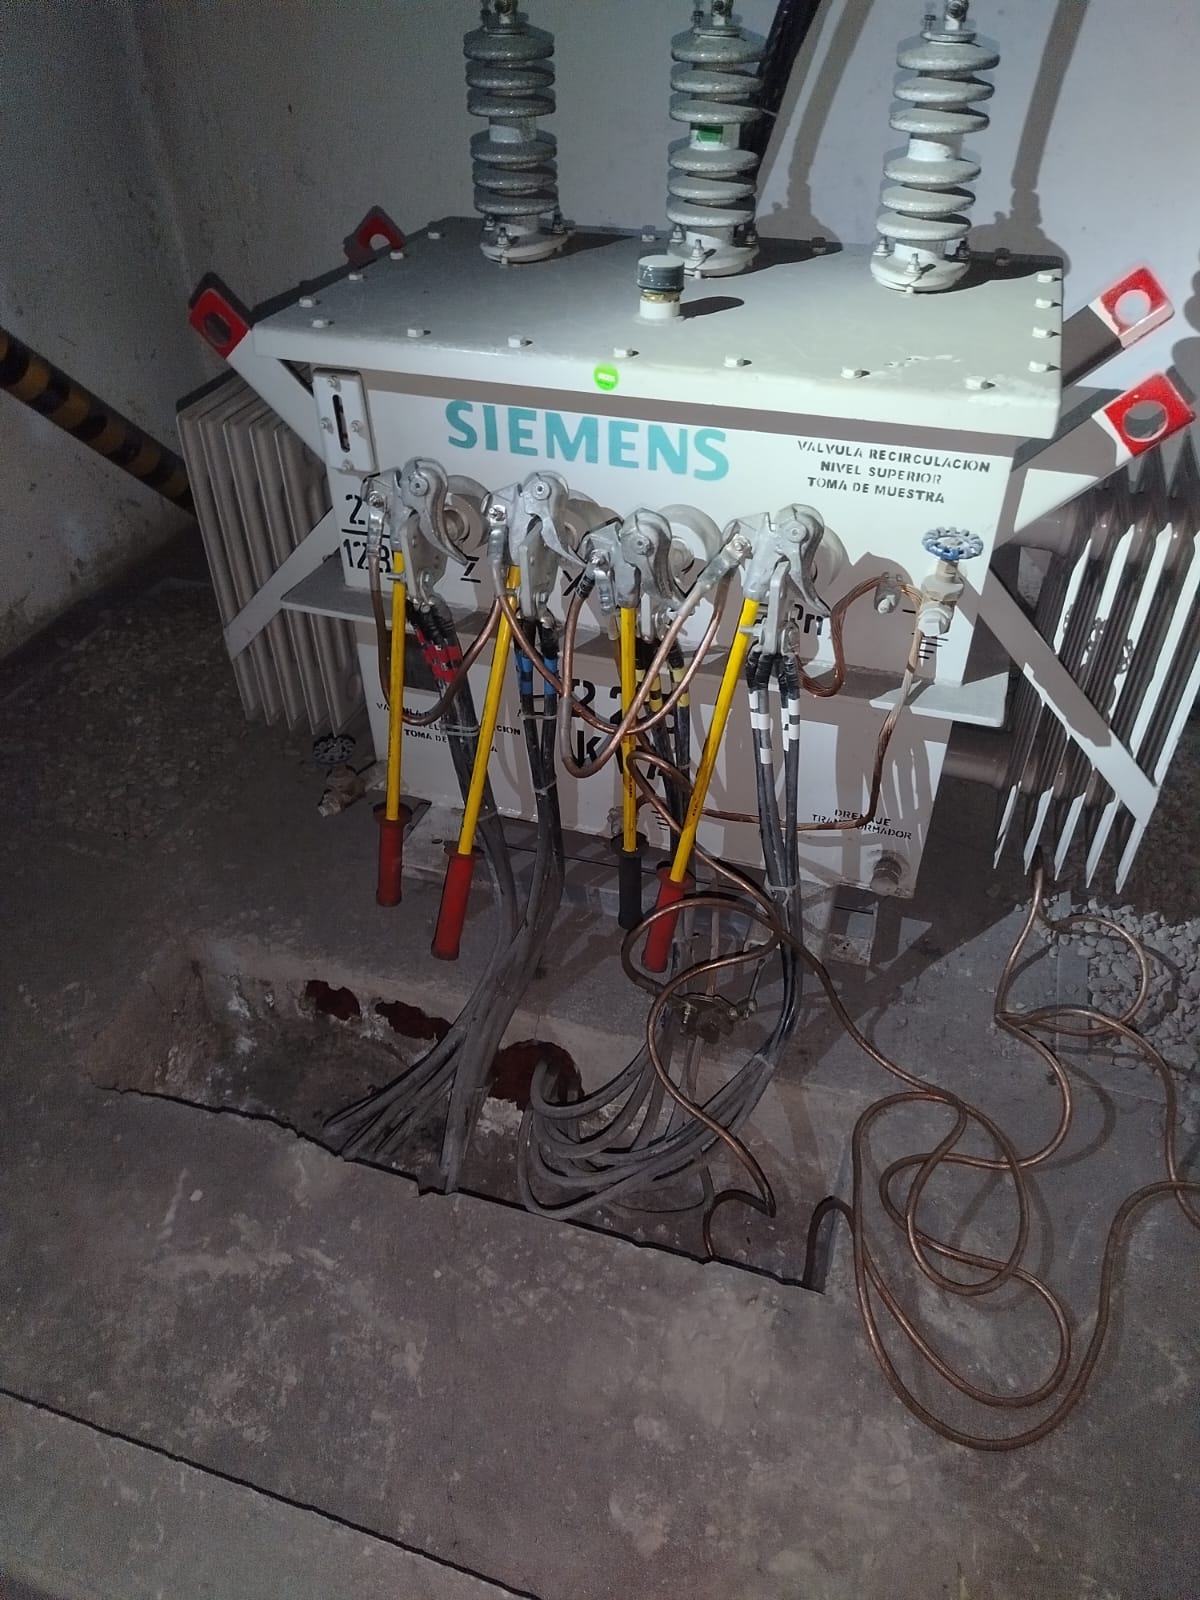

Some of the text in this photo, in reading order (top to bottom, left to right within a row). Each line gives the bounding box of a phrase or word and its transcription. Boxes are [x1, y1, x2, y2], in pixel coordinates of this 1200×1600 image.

[445, 399, 729, 482] SIEMENS
[798, 440, 991, 473] VALVULA RECIRCULACION
[820, 461, 942, 484] NIVEL SUPERIOR
[807, 477, 944, 503] TOMA DE MUESTRA
[403, 728, 433, 740] TOMA
